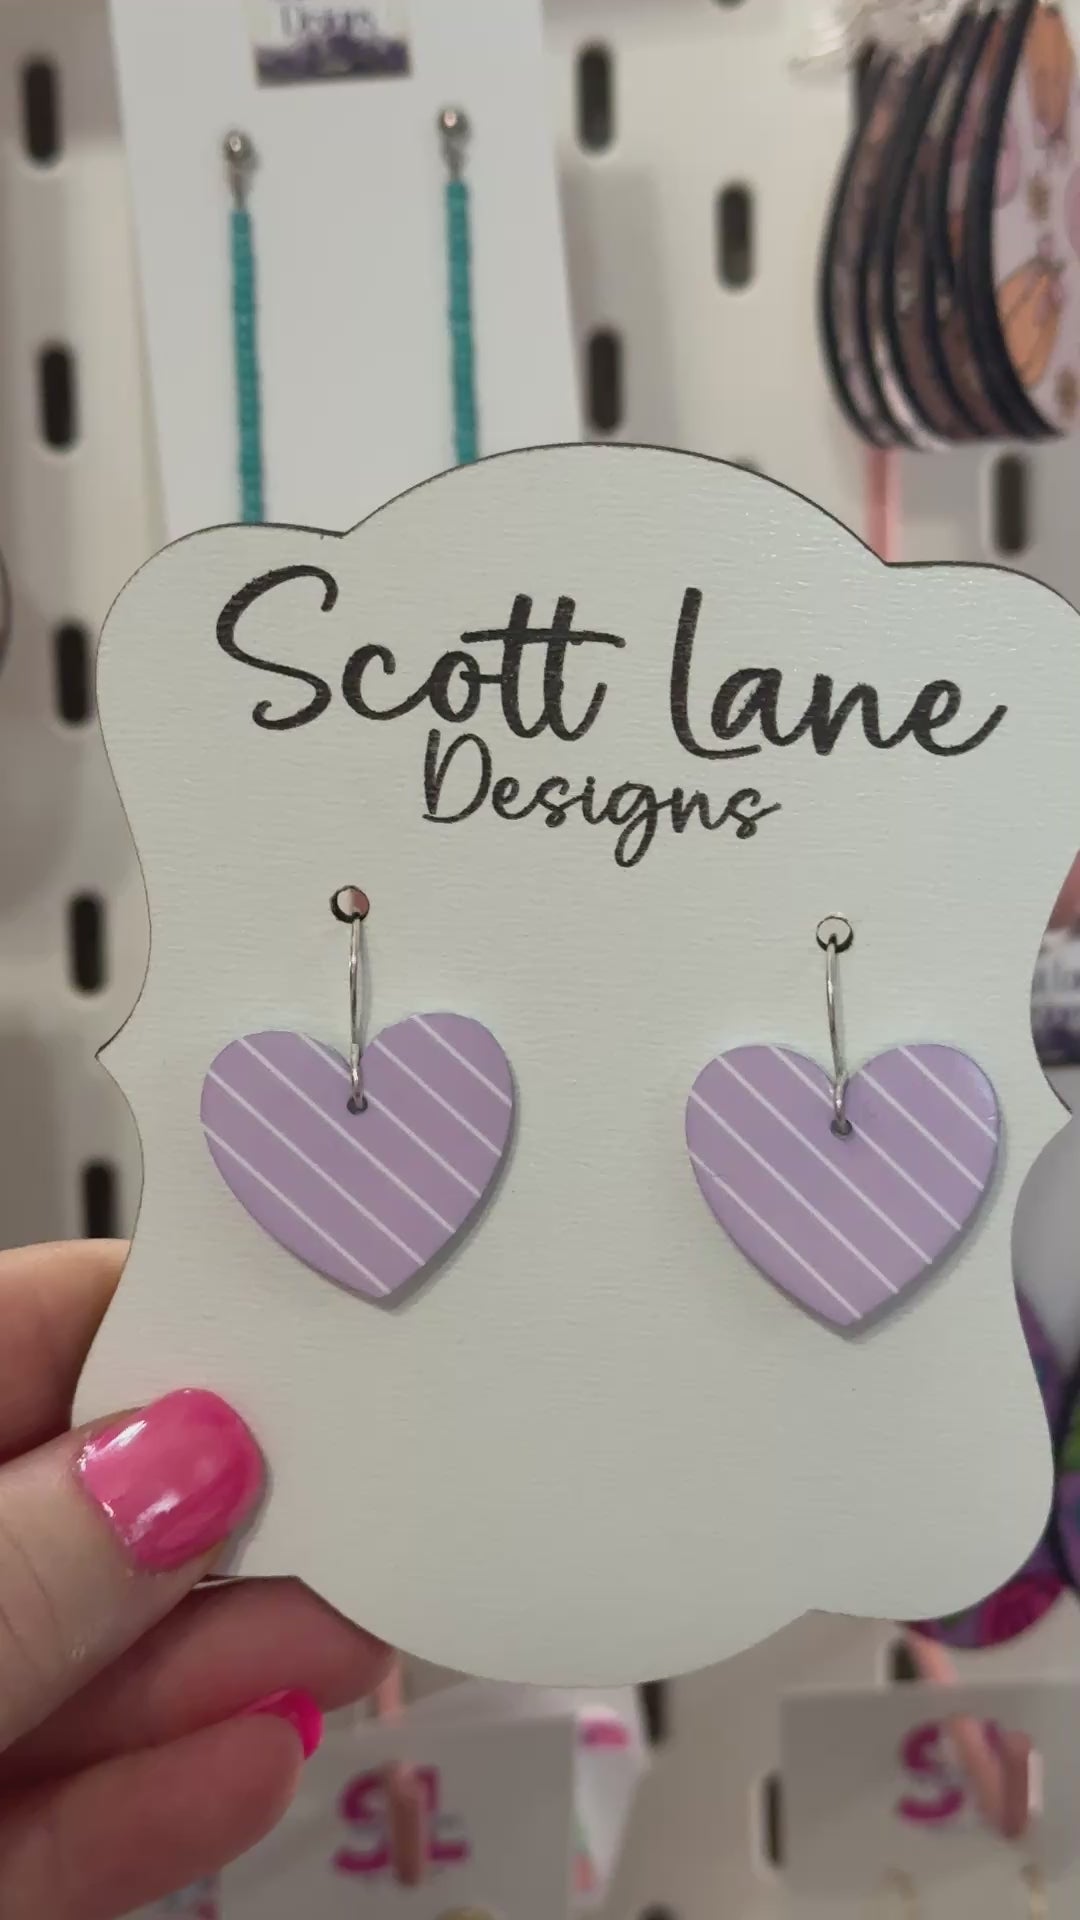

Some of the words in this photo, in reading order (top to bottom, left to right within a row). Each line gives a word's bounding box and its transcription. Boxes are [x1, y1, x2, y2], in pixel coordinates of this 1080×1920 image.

[216, 565, 626, 741] Scott
[669, 587, 1008, 759] Lane
[423, 728, 781, 868] Designs
